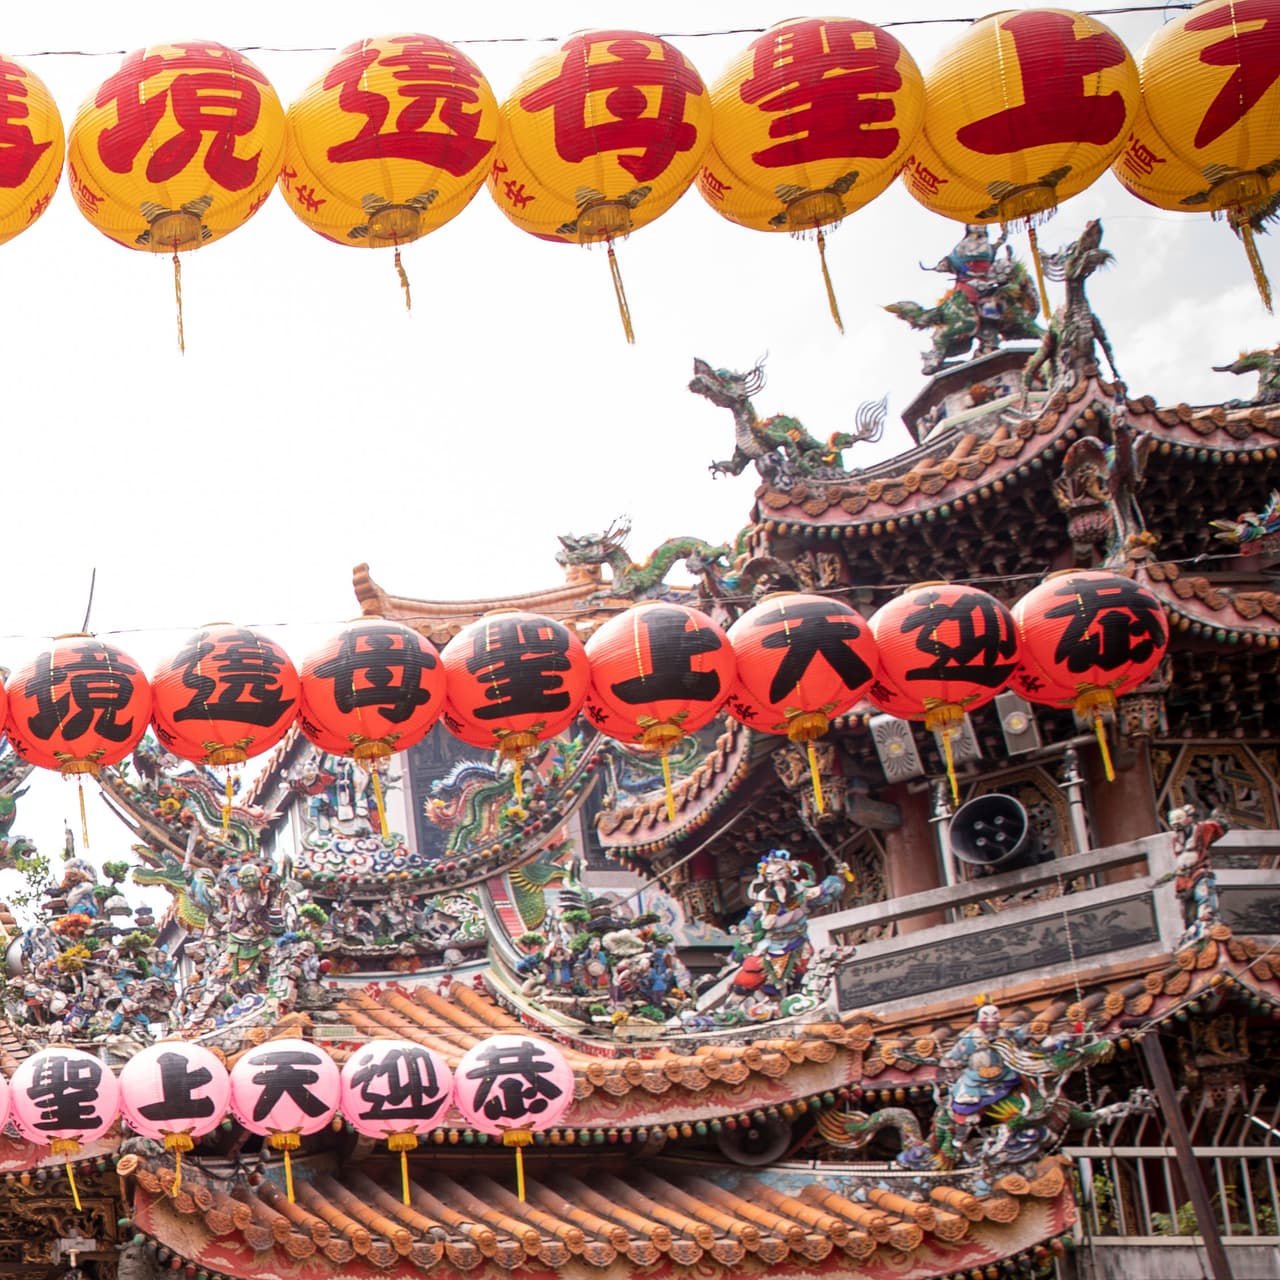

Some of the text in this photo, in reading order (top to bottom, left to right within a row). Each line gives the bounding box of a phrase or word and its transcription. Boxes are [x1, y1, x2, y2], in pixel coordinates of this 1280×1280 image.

[95, 40, 270, 193] 境
[521, 30, 703, 182] 母
[740, 19, 902, 168] 聖
[956, 11, 1126, 155] 上
[313, 624, 437, 724] 母
[467, 618, 571, 720] 聖
[612, 608, 722, 702] 上
[754, 601, 873, 703] 天
[902, 591, 1025, 687] 迎
[1044, 576, 1166, 674] 恭
[25, 640, 137, 743] 境
[26, 1055, 103, 1131] 聖
[137, 1052, 216, 1120] 上
[248, 1051, 331, 1122] 天
[350, 1047, 450, 1121] 迎
[467, 1040, 563, 1121] 恭
